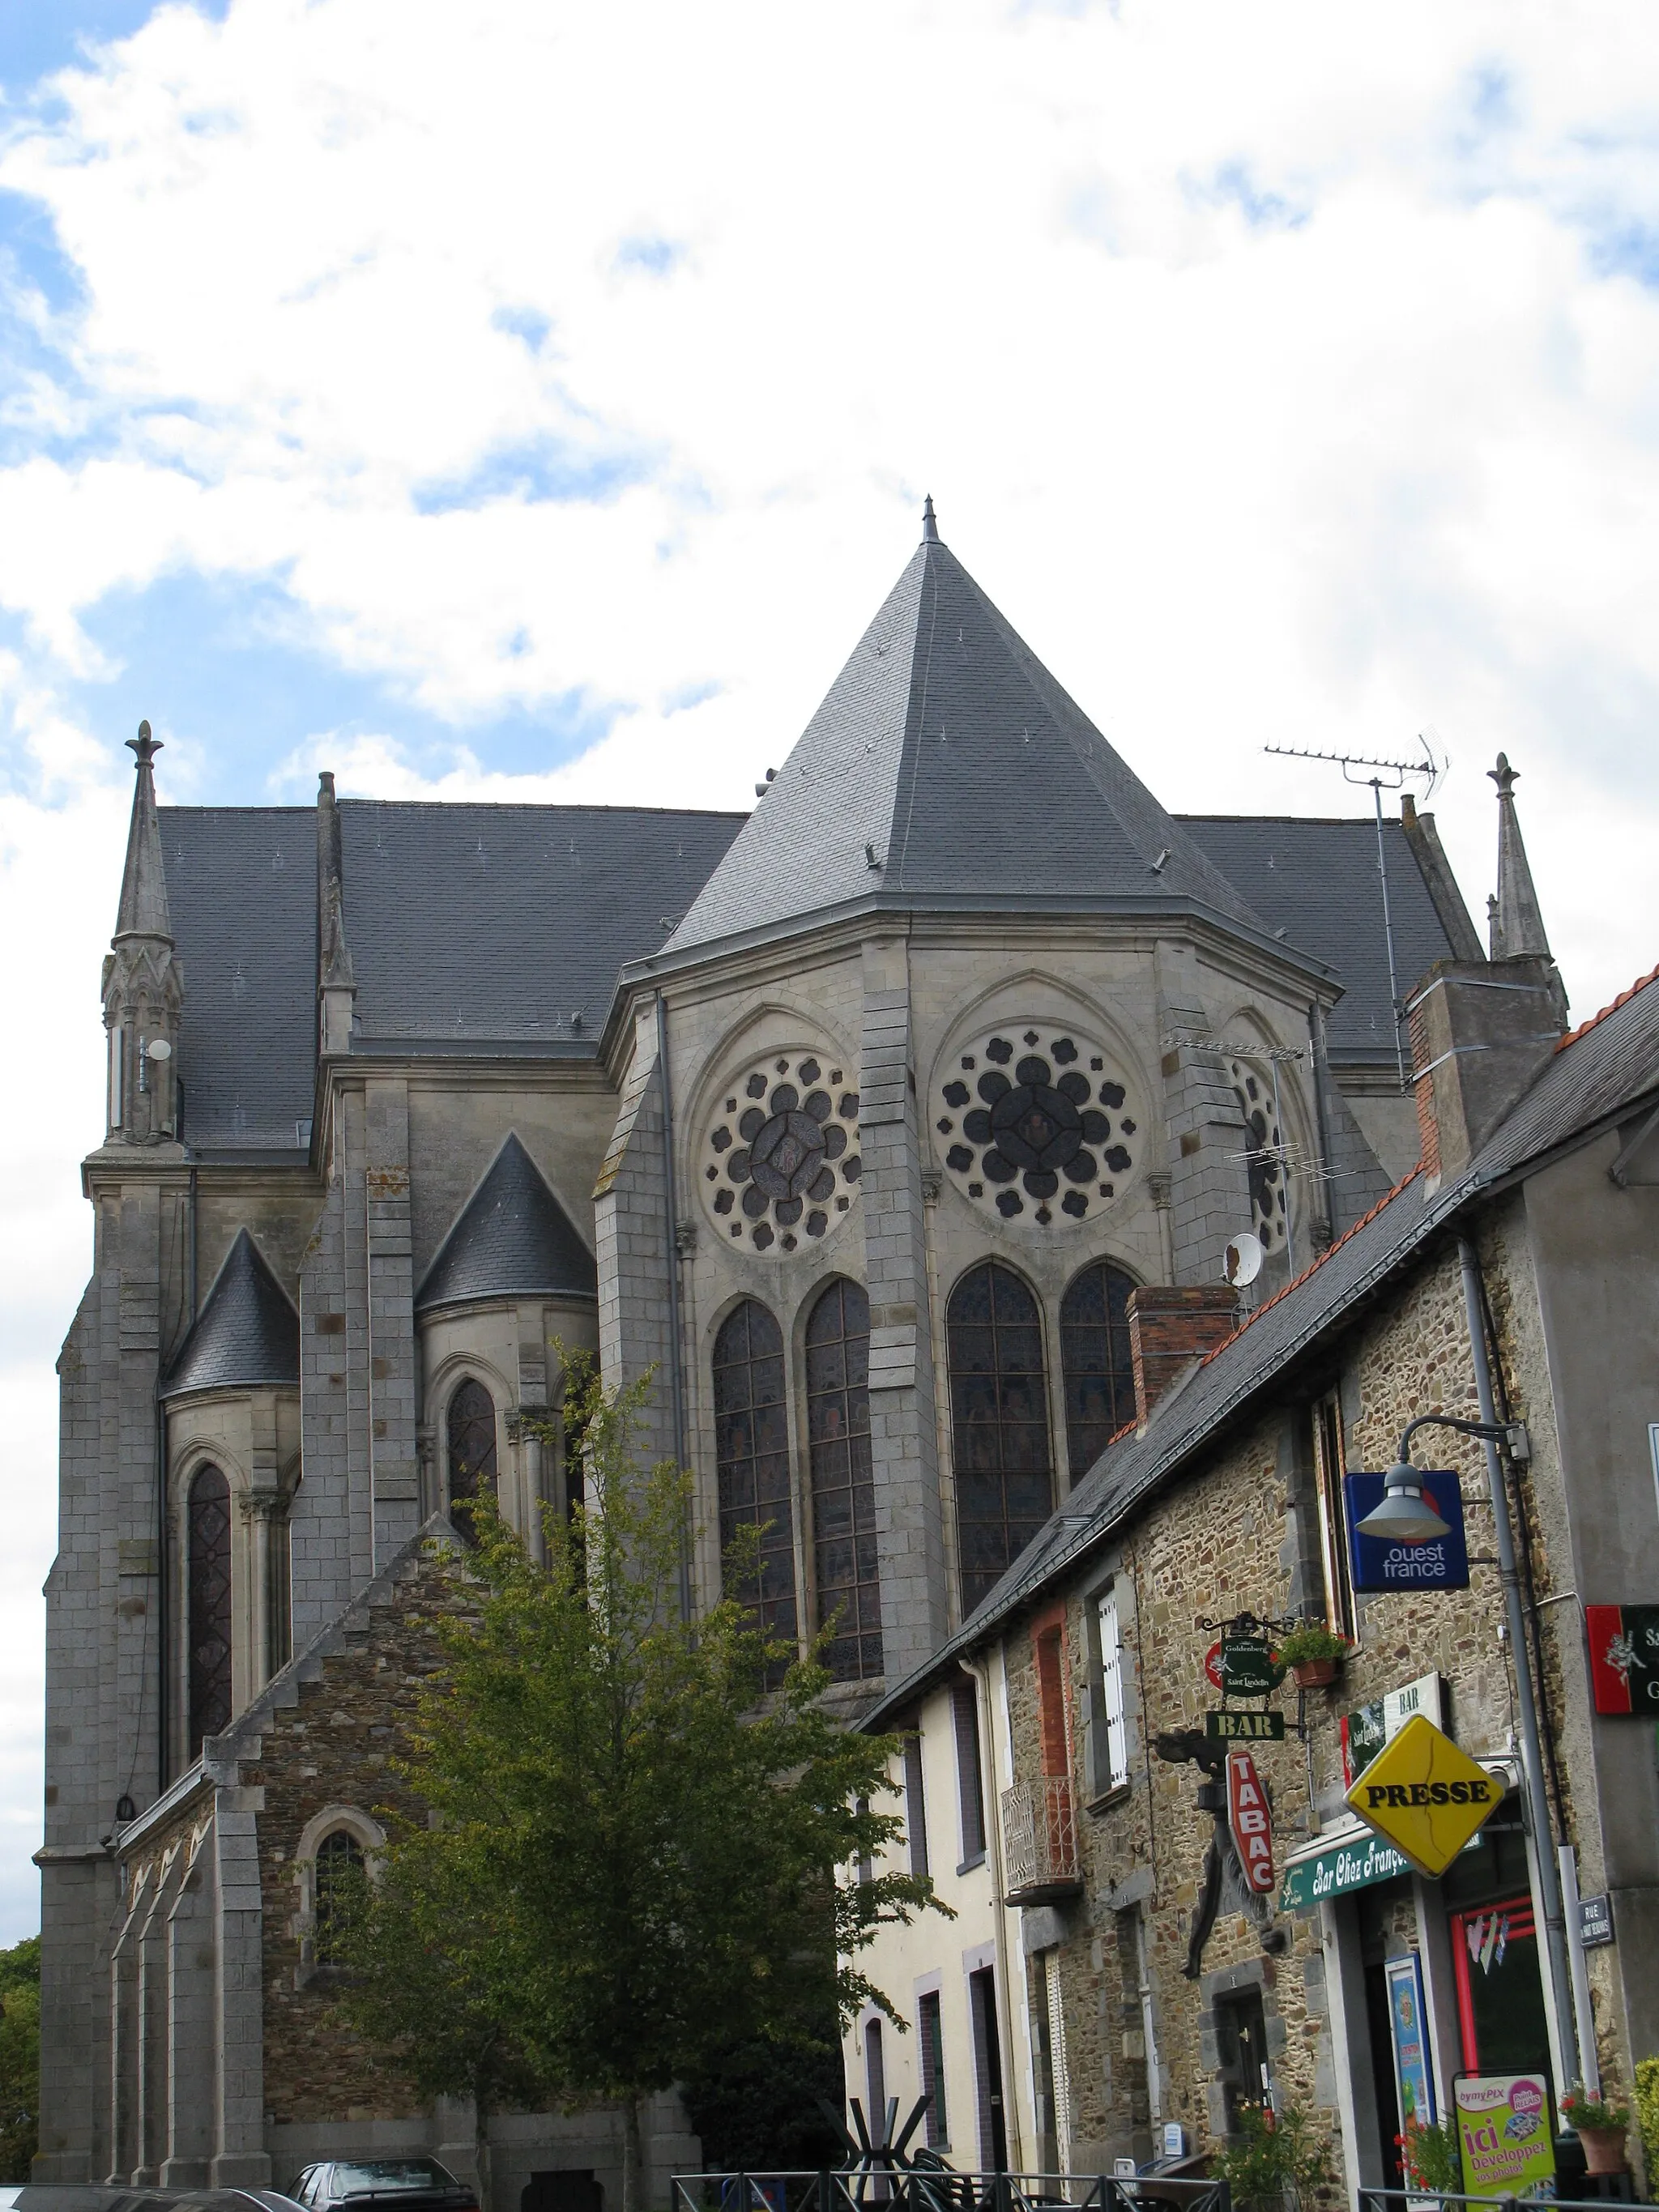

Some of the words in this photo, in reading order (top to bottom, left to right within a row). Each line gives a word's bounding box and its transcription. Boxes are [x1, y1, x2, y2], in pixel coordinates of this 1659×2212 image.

[1389, 1544, 1445, 1562] ouest
[1383, 1560, 1446, 1578] france
[1399, 1687, 1419, 1715] BAR
[1218, 1715, 1273, 1737] BAR
[1366, 1780, 1491, 1808] PRESSE
[1233, 1757, 1272, 1886] TABAC
[1313, 1861, 1333, 1895] Bar
[1337, 1852, 1361, 1886] Chez
[1584, 1904, 1598, 1920] RUE
[1460, 2089, 1504, 2102] bymyPIX
[1515, 2091, 1532, 2102] Point
[1515, 2095, 1540, 2109] RELAIS
[1462, 2117, 1499, 2155] ici
[1471, 2141, 1546, 2171] Développez
[1475, 2173, 1491, 2182] vos
[1492, 2163, 1523, 2180] photos
